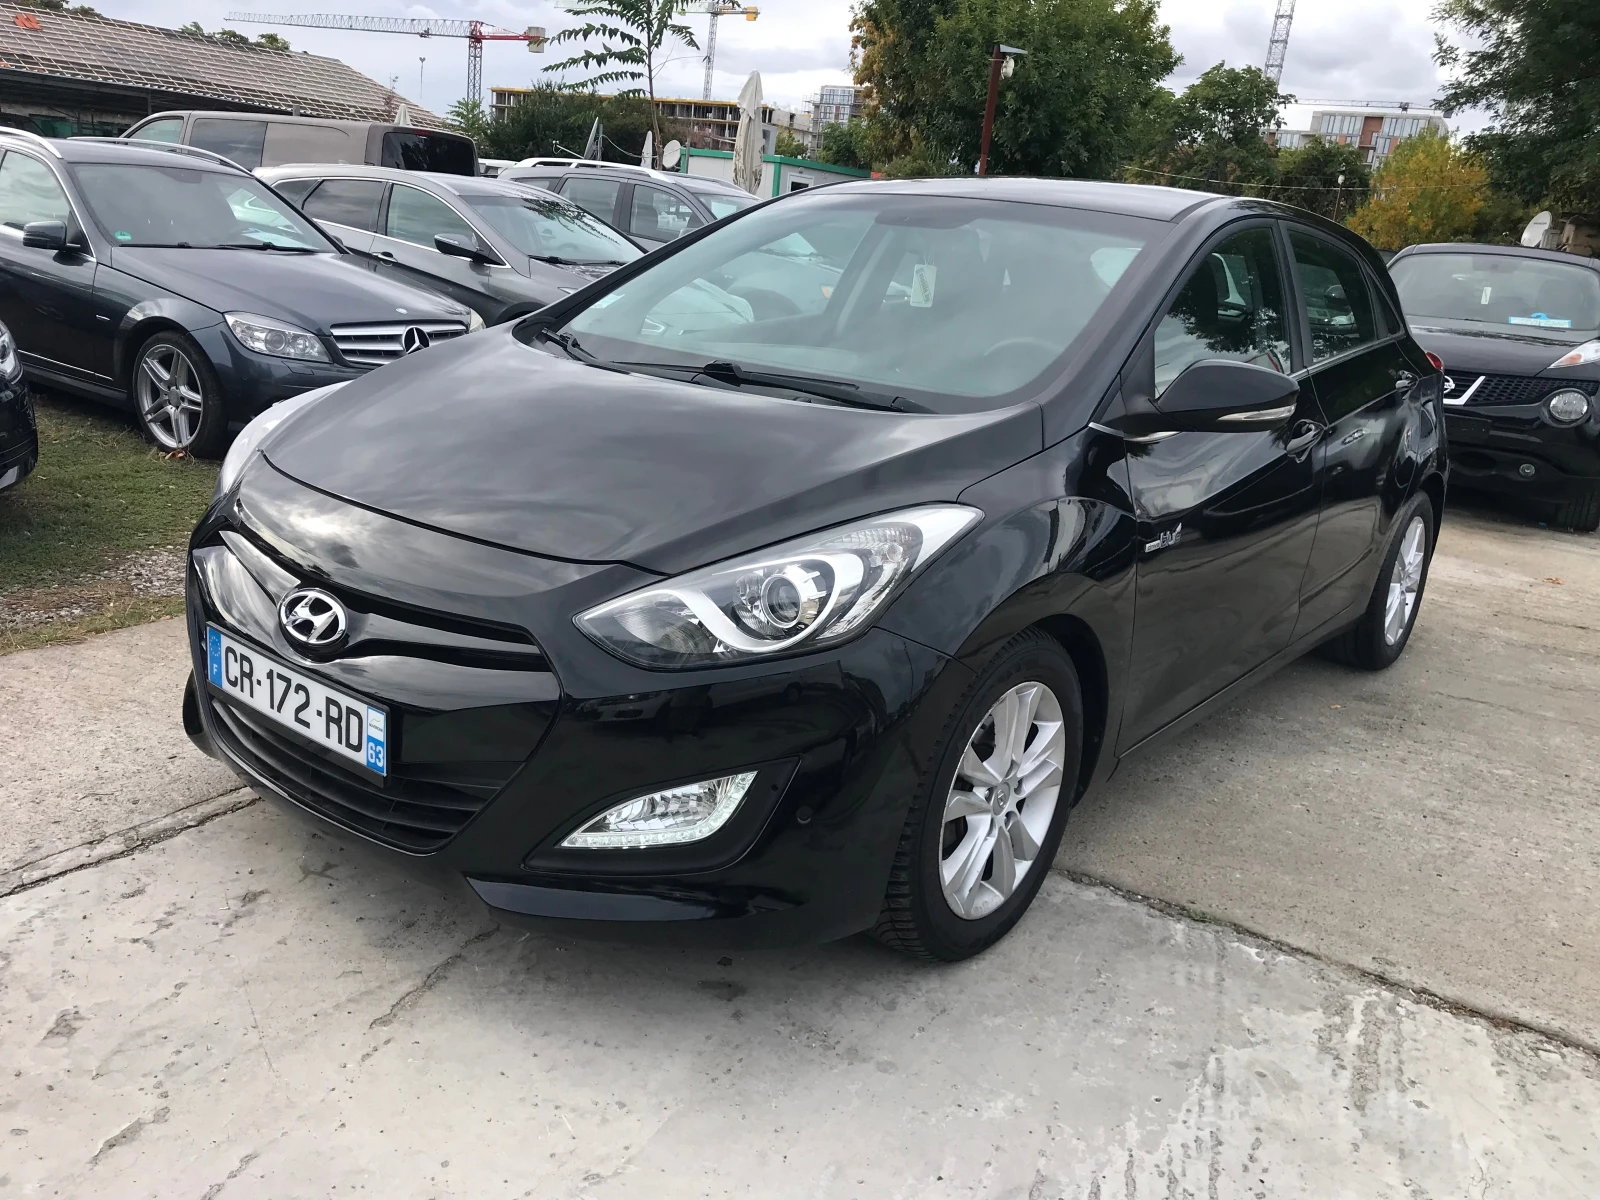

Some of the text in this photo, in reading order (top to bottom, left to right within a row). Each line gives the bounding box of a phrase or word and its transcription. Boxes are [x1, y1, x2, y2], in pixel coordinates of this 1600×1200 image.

[213, 664, 218, 675] F
[225, 646, 363, 752] CR-172-RD
[368, 742, 383, 767] 63
